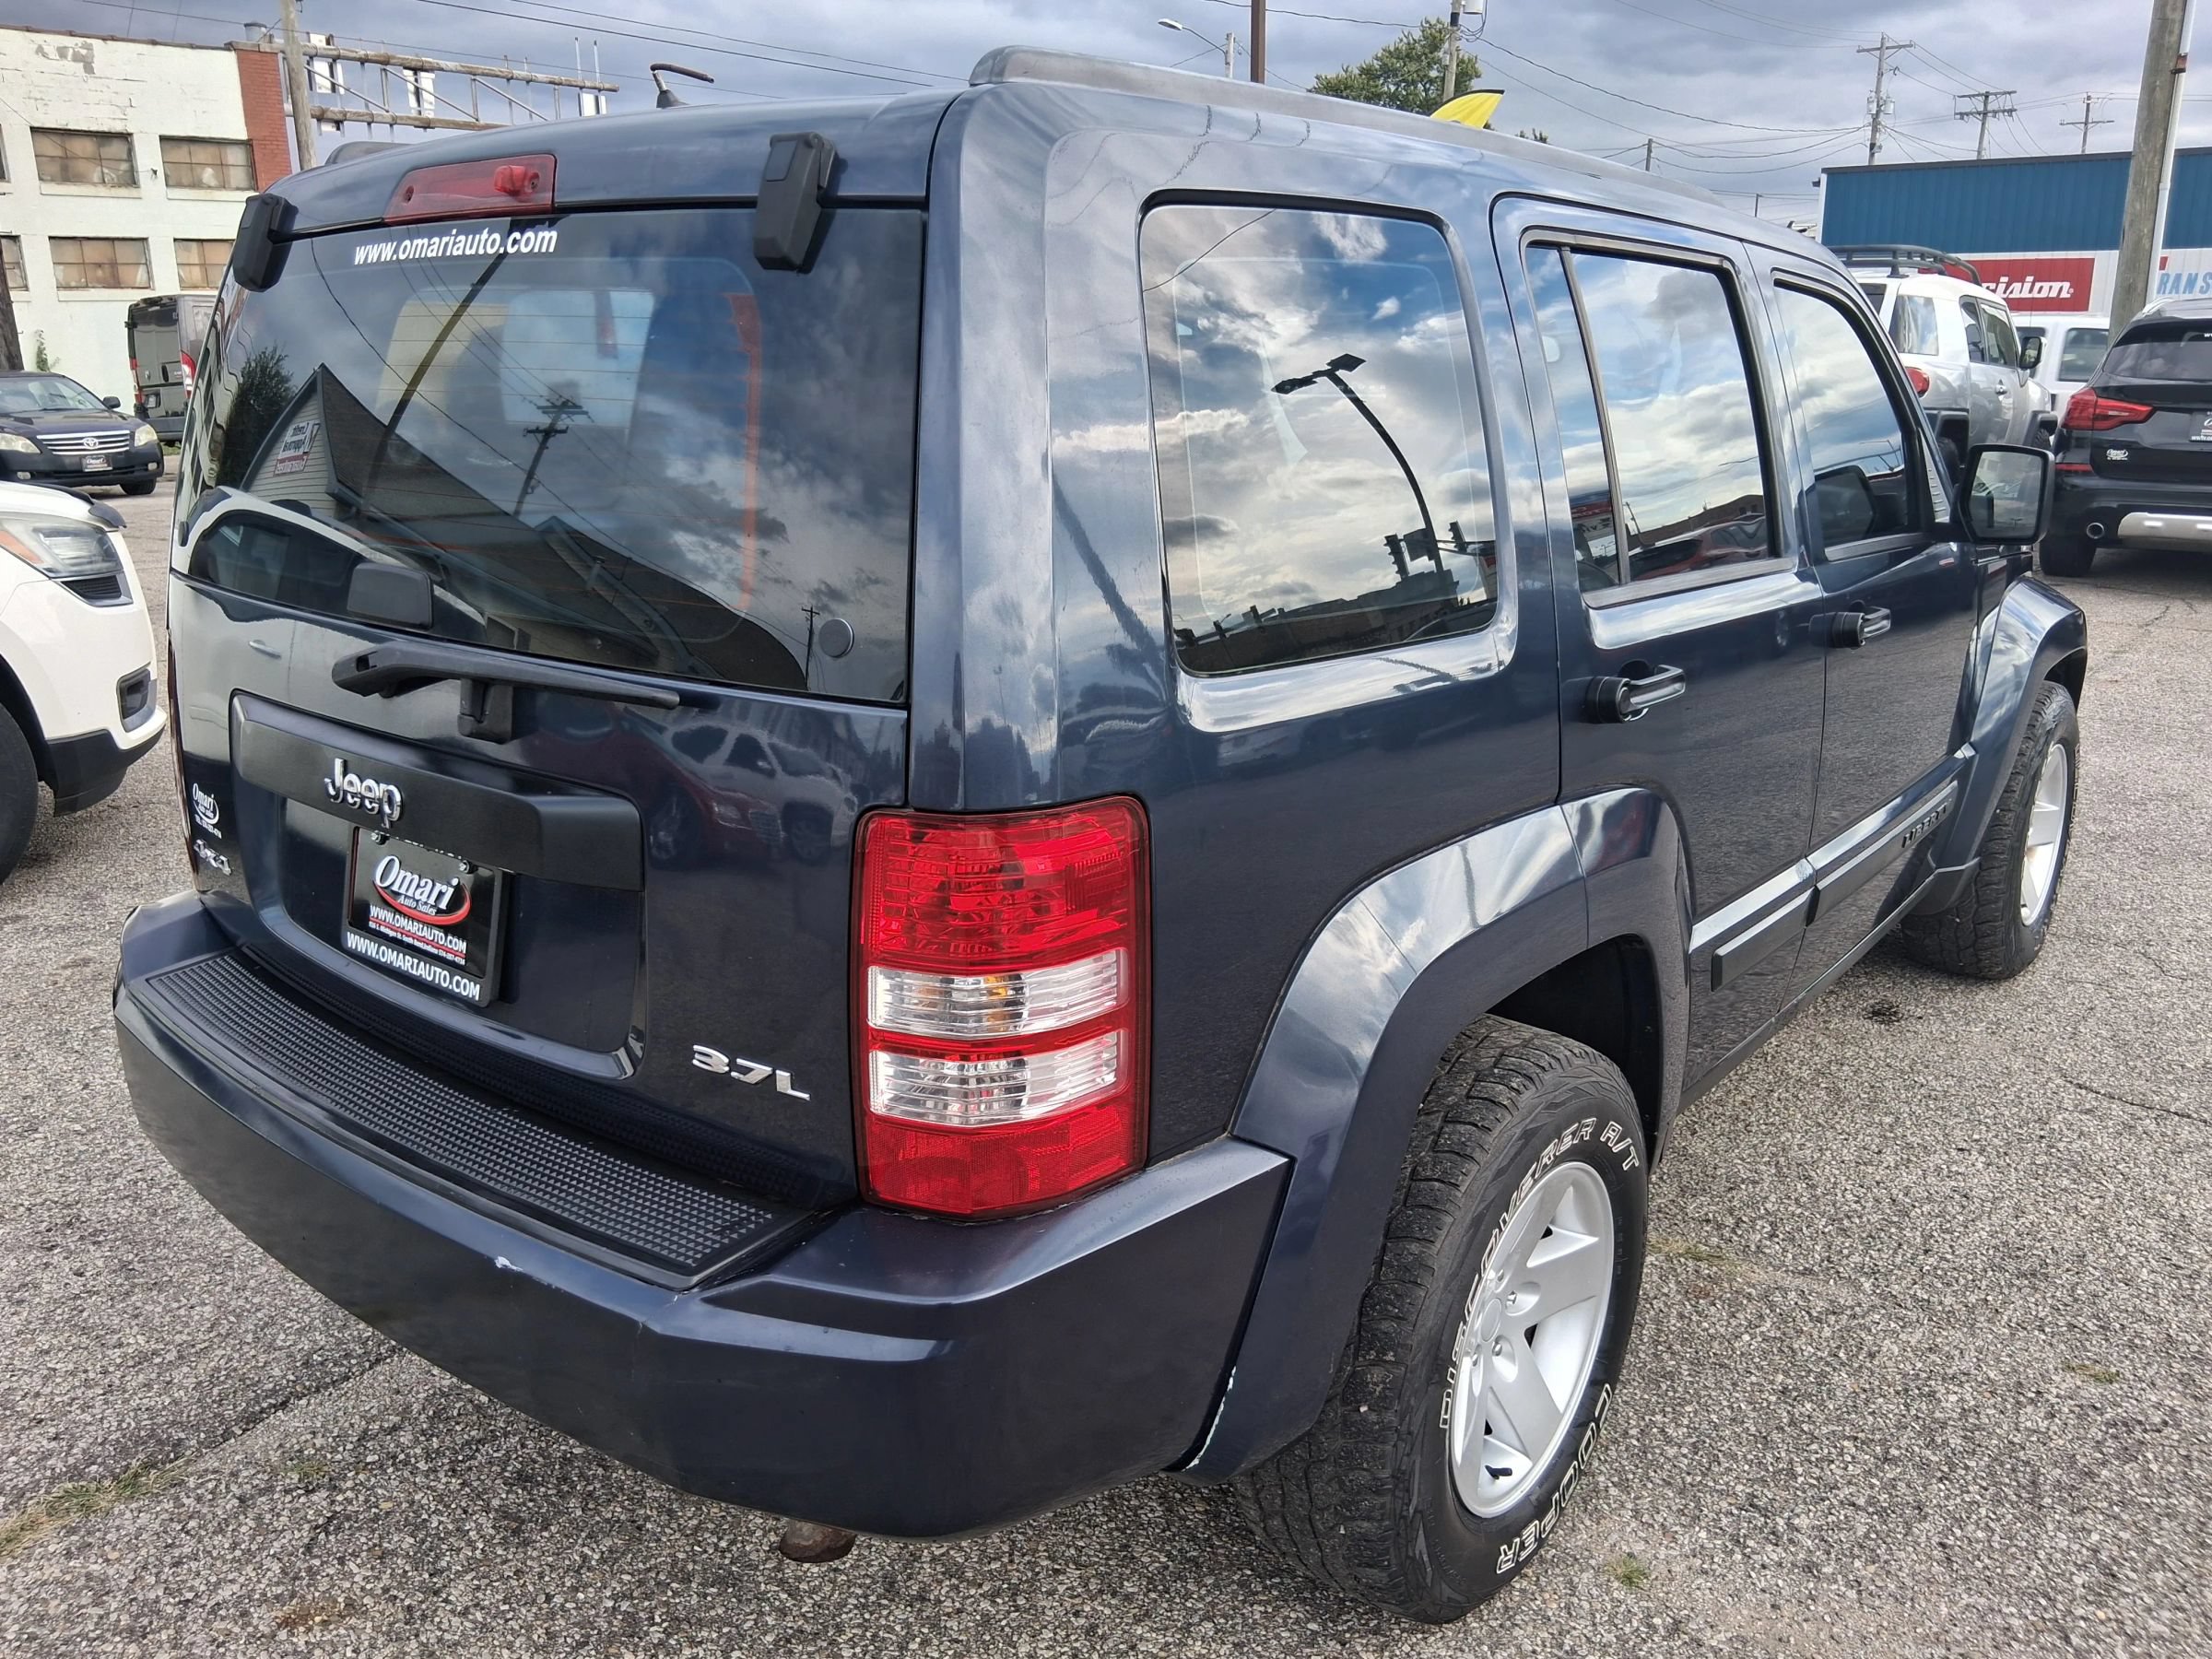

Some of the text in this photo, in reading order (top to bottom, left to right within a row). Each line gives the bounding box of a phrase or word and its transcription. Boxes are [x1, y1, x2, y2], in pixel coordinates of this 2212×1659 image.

[354, 227, 558, 265] www.omariauto.com
[1982, 276, 2072, 299] cision
[192, 783, 215, 812] Omari
[324, 758, 402, 830] Jeep
[1900, 798, 1952, 849] LIBERTY
[194, 839, 232, 877] 4x4
[375, 854, 459, 911] Omari
[370, 905, 467, 954] WWW.OMARIAUTO.COM
[397, 894, 438, 916] Auto Sales
[347, 931, 480, 1002] WWW.OMARIAUTO.COM
[692, 1044, 811, 1101] 3.7L
[1599, 1121, 1641, 1171] A/T
[1496, 1382, 1613, 1575] COOPER
